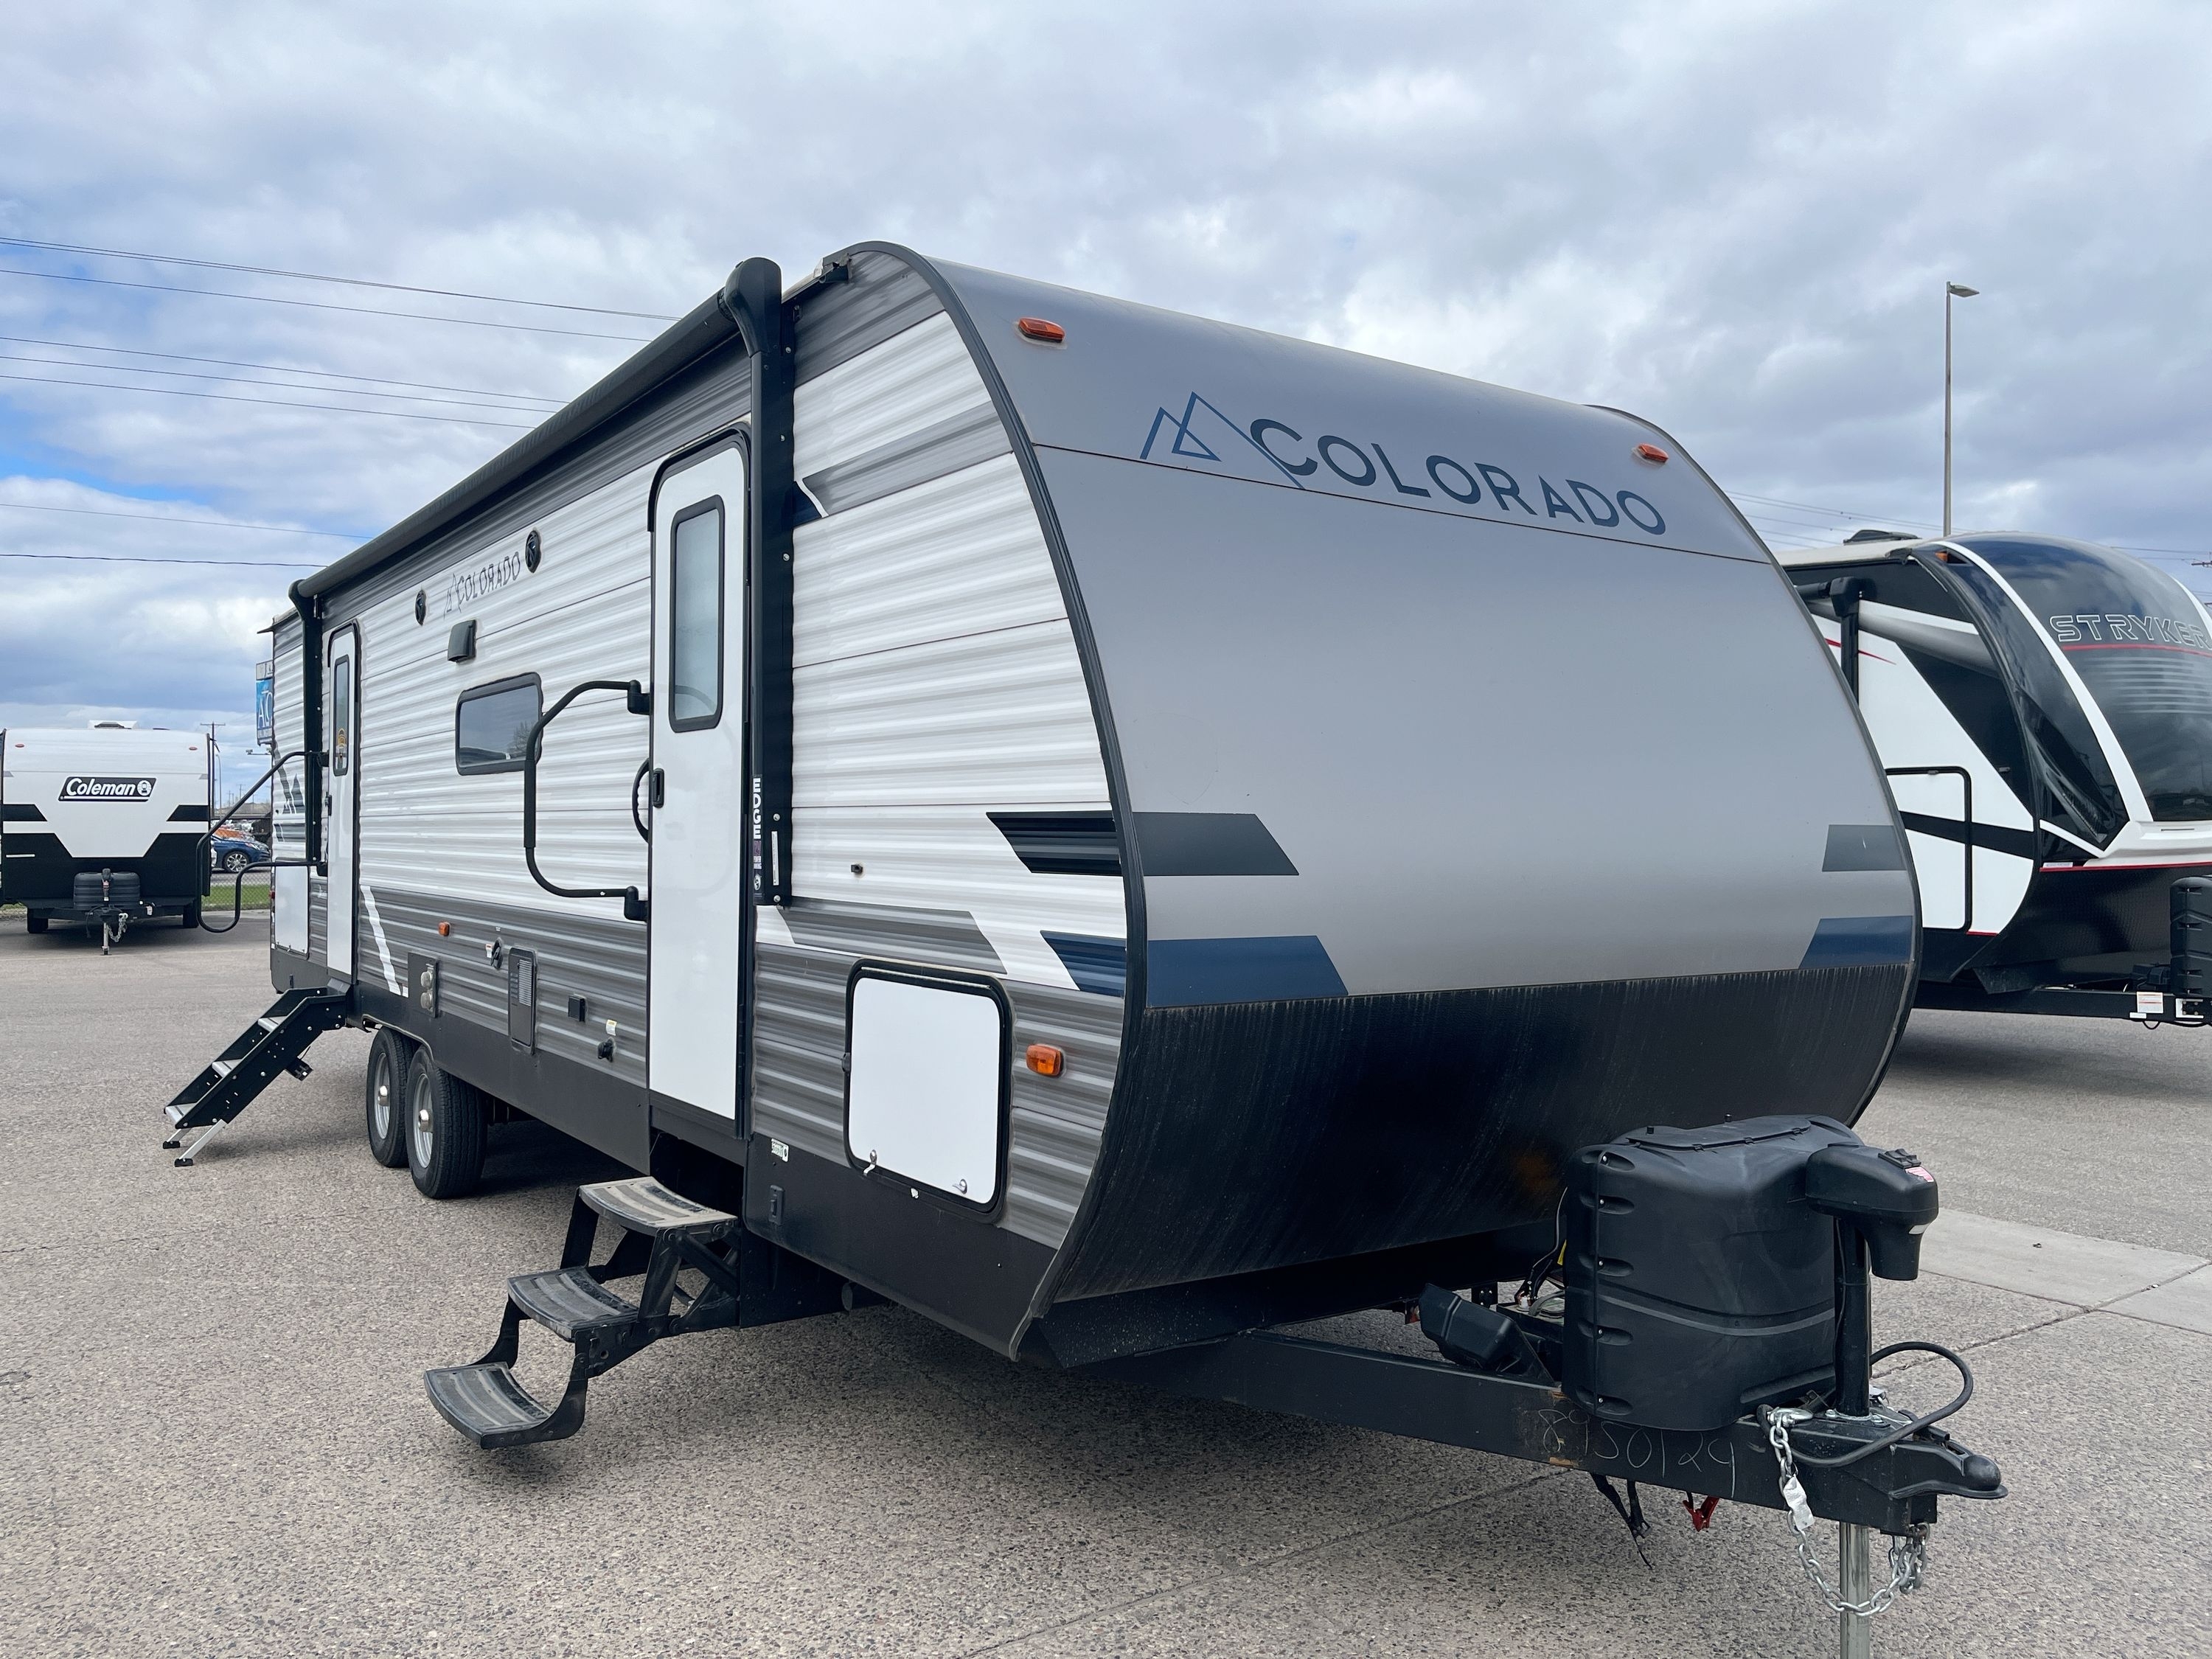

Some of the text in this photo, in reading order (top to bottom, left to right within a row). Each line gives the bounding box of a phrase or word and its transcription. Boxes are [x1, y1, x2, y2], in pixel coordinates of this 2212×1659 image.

[1250, 418, 1666, 535] COLORADO
[456, 551, 521, 605] COLORADO
[2049, 613, 2212, 650] STRYKER
[66, 777, 136, 796] Coleman
[752, 777, 762, 839] EDGE
